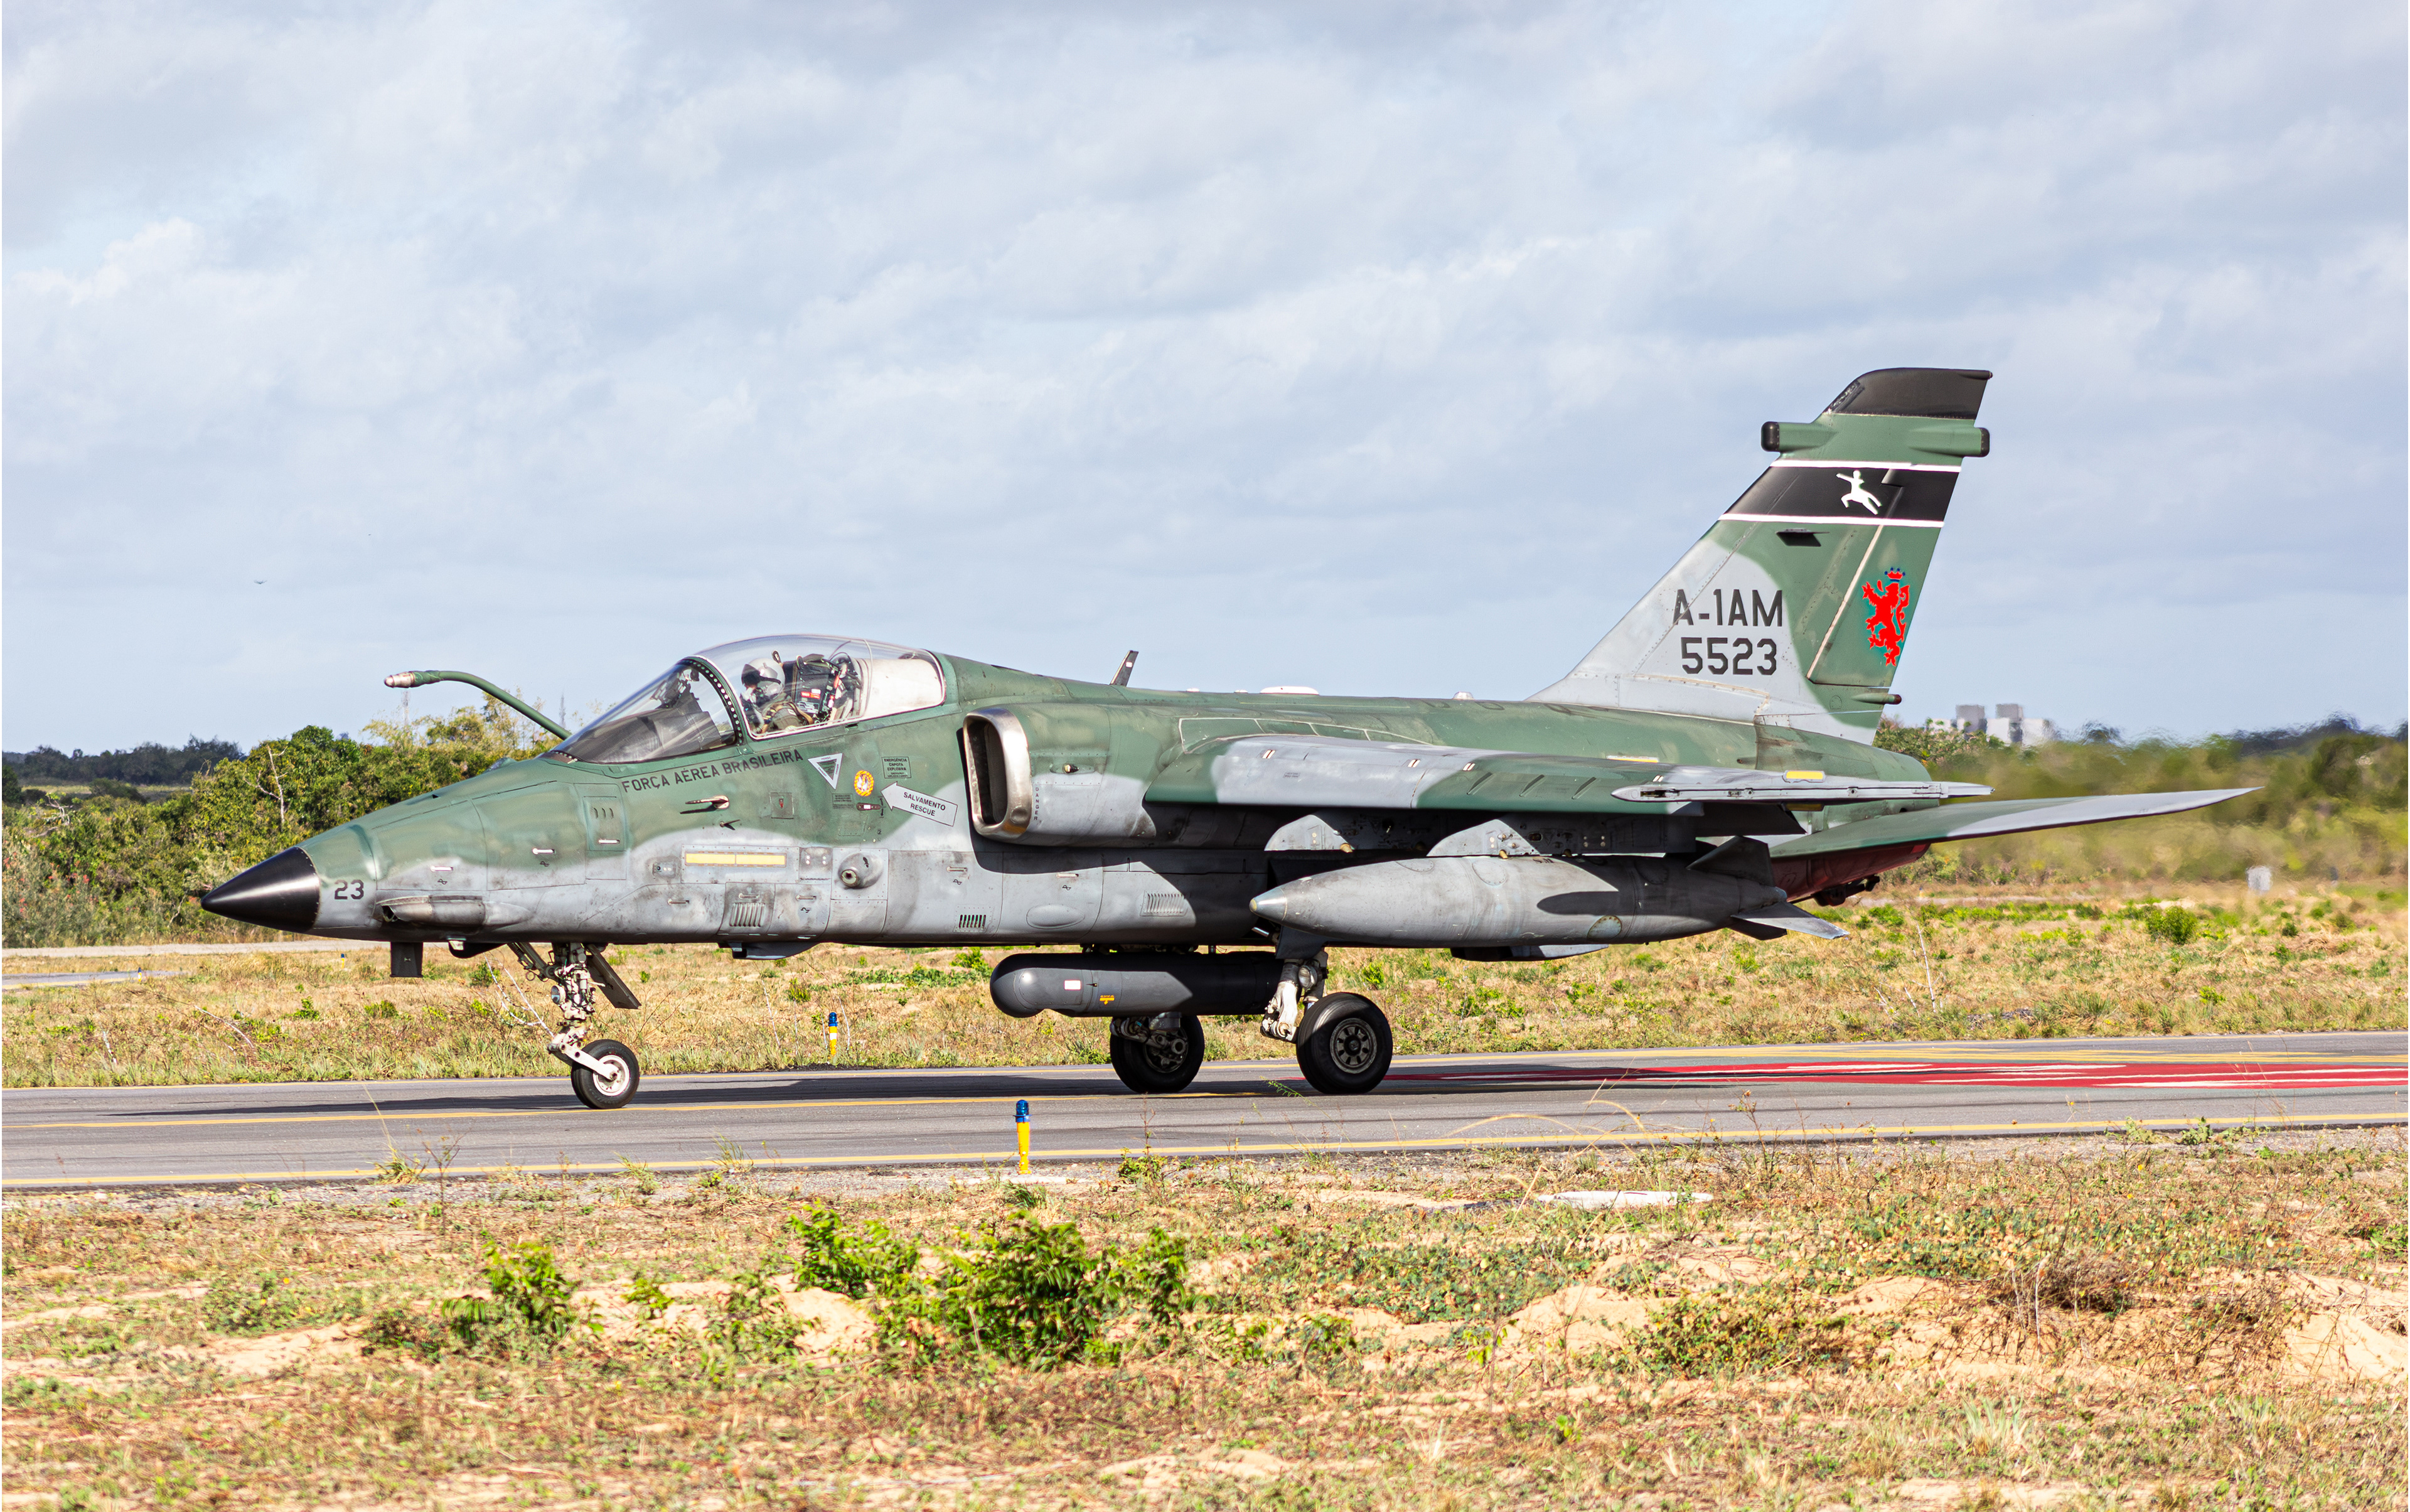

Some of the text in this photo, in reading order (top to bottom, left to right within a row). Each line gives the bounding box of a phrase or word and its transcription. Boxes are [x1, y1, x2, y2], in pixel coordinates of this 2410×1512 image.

[1673, 589, 1782, 626] A-1AM
[1681, 636, 1777, 675] 5523
[621, 749, 804, 793] FORÇA AÉREA BRASILEIRA
[903, 791, 946, 811] SALVAMENTO
[910, 803, 936, 817] RESCUE
[335, 879, 364, 899] 23
